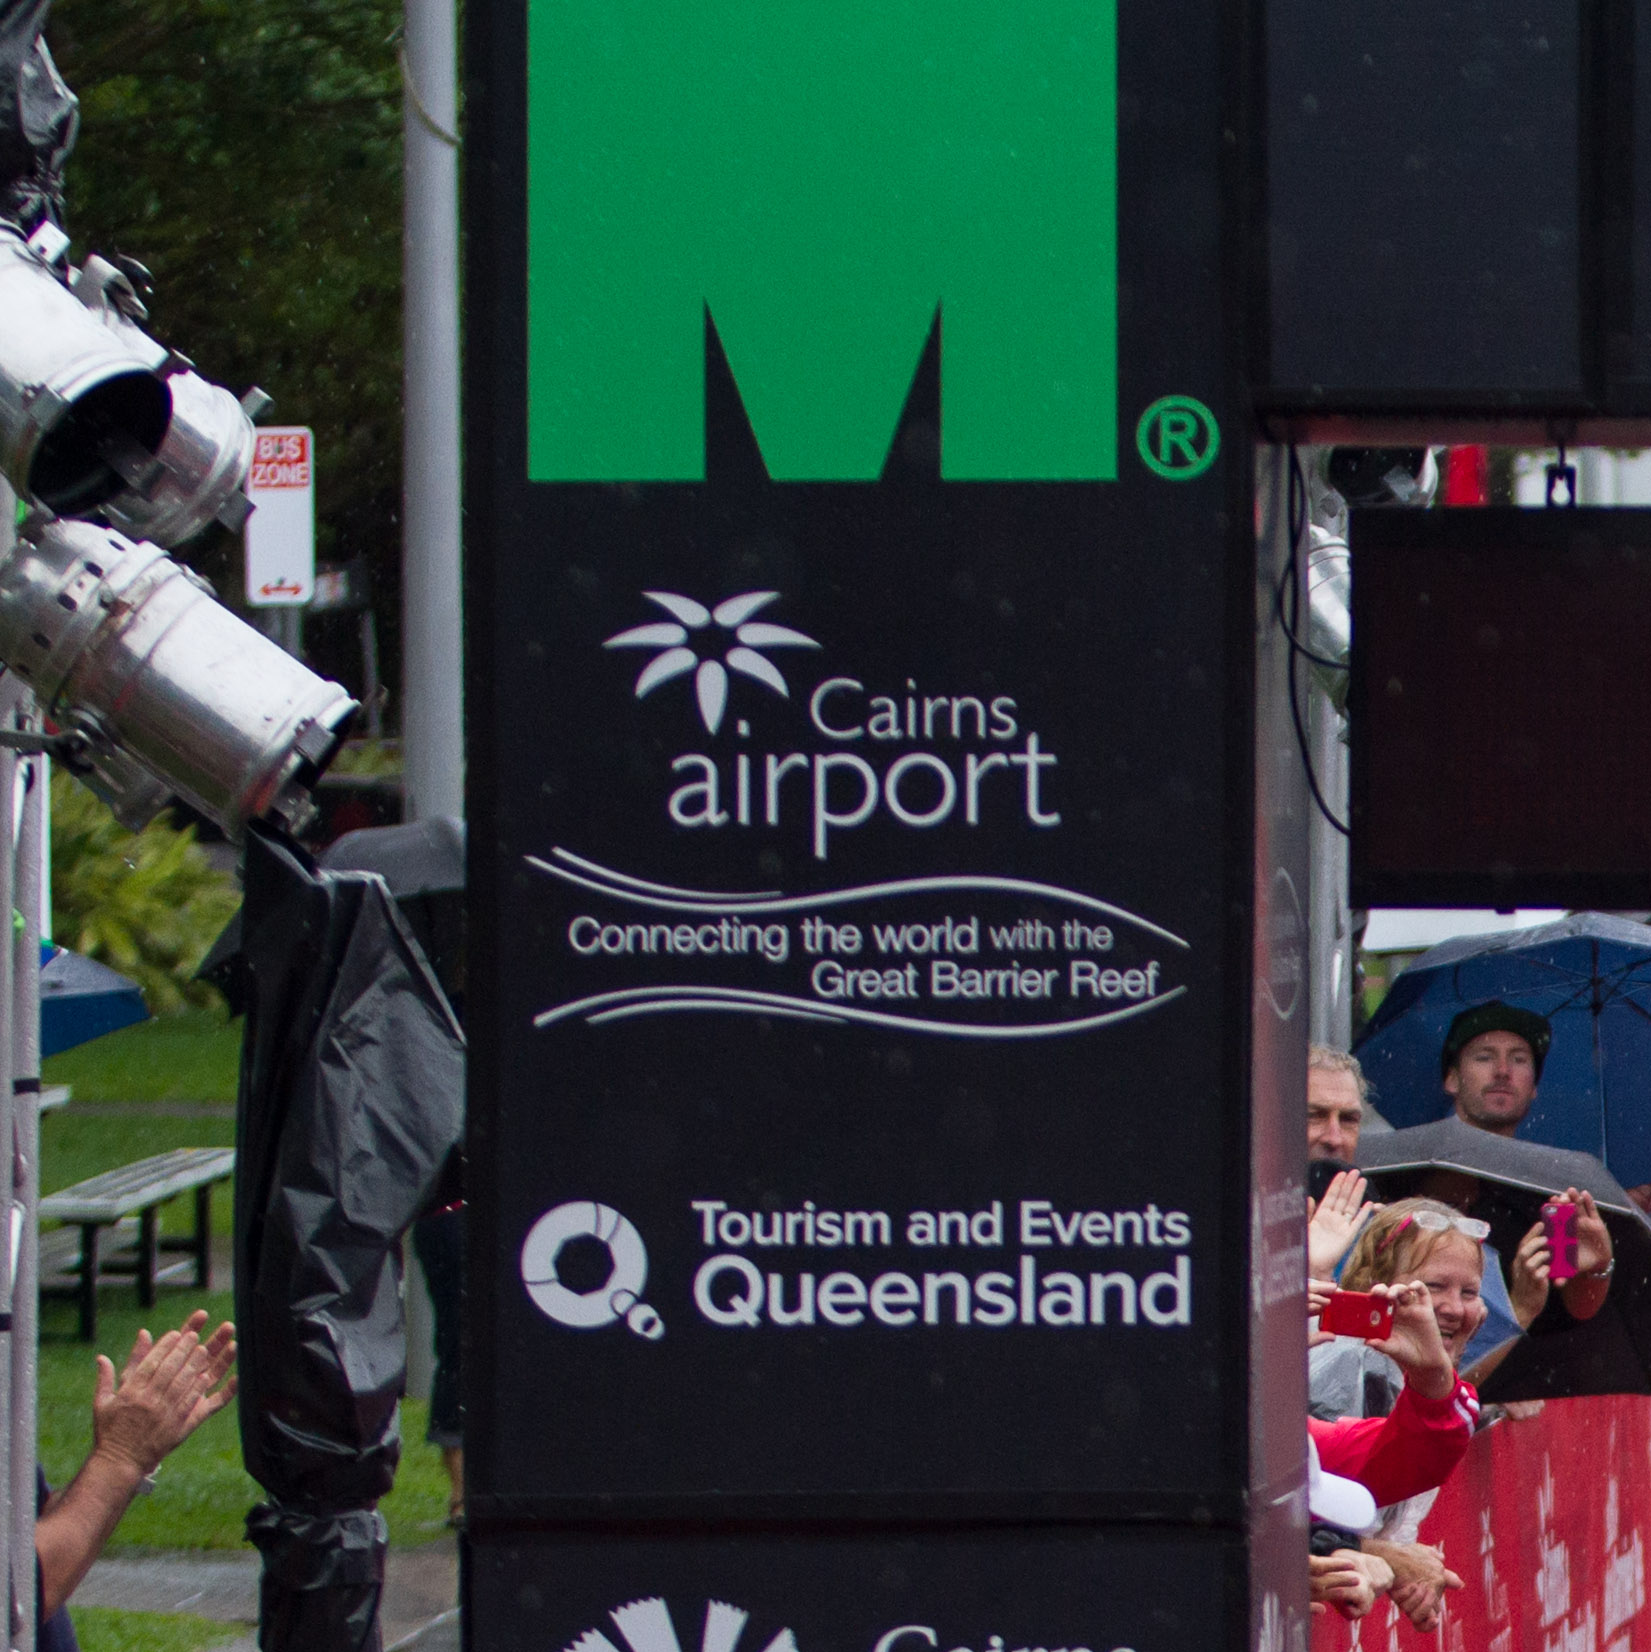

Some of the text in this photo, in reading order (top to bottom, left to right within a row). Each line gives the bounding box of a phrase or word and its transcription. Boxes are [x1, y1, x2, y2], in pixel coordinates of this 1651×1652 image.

[260, 436, 301, 460] BUS
[253, 463, 309, 485] ZONE
[810, 678, 1017, 739] Cairns
[668, 718, 1061, 860] airport
[568, 916, 1113, 962] Connecting the world with the
[811, 958, 1161, 1001] Great Barrier Reef
[691, 1200, 1191, 1246] Tourism and Events
[693, 1254, 1190, 1327] Queensland
